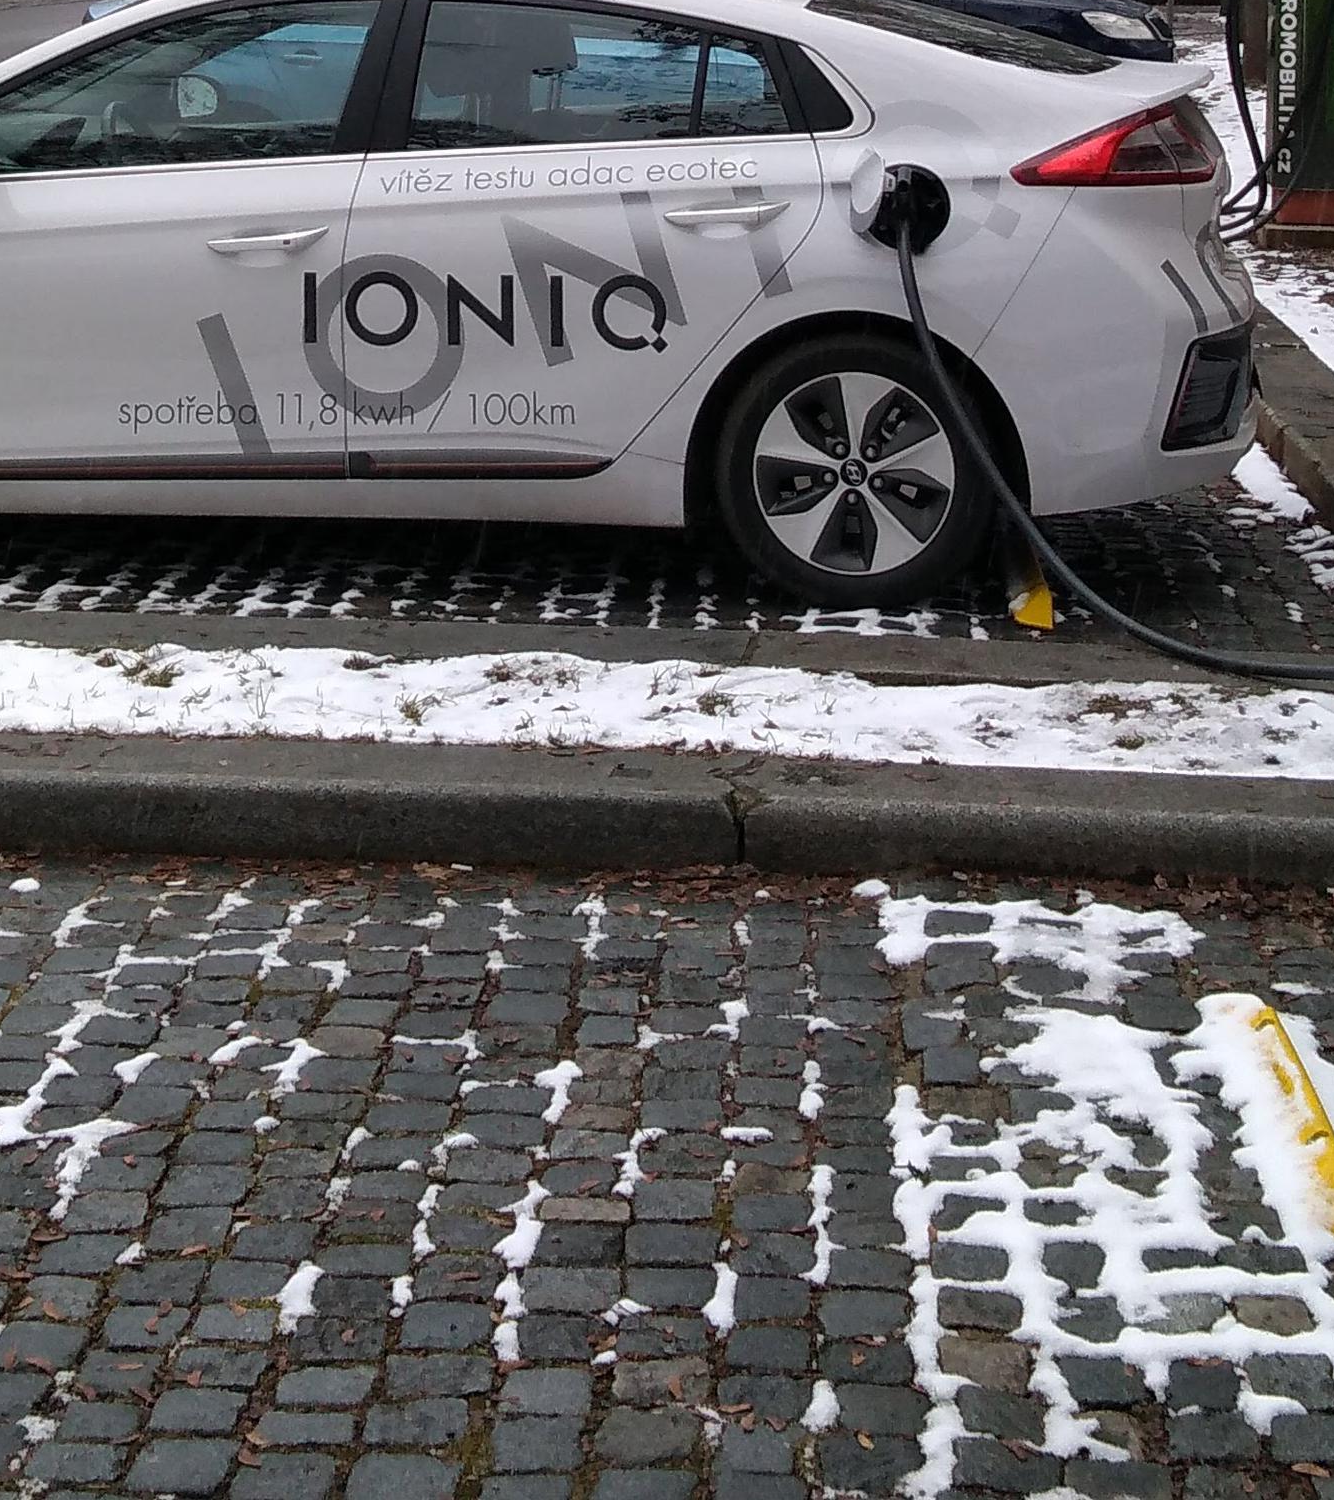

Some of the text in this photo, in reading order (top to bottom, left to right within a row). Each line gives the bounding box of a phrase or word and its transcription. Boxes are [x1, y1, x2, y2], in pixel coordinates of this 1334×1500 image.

[380, 156, 758, 194] vítěz testu adac ecotec
[303, 271, 669, 353] IONIQ
[118, 389, 576, 434] spotřeba 11,8 kwh / 100km
